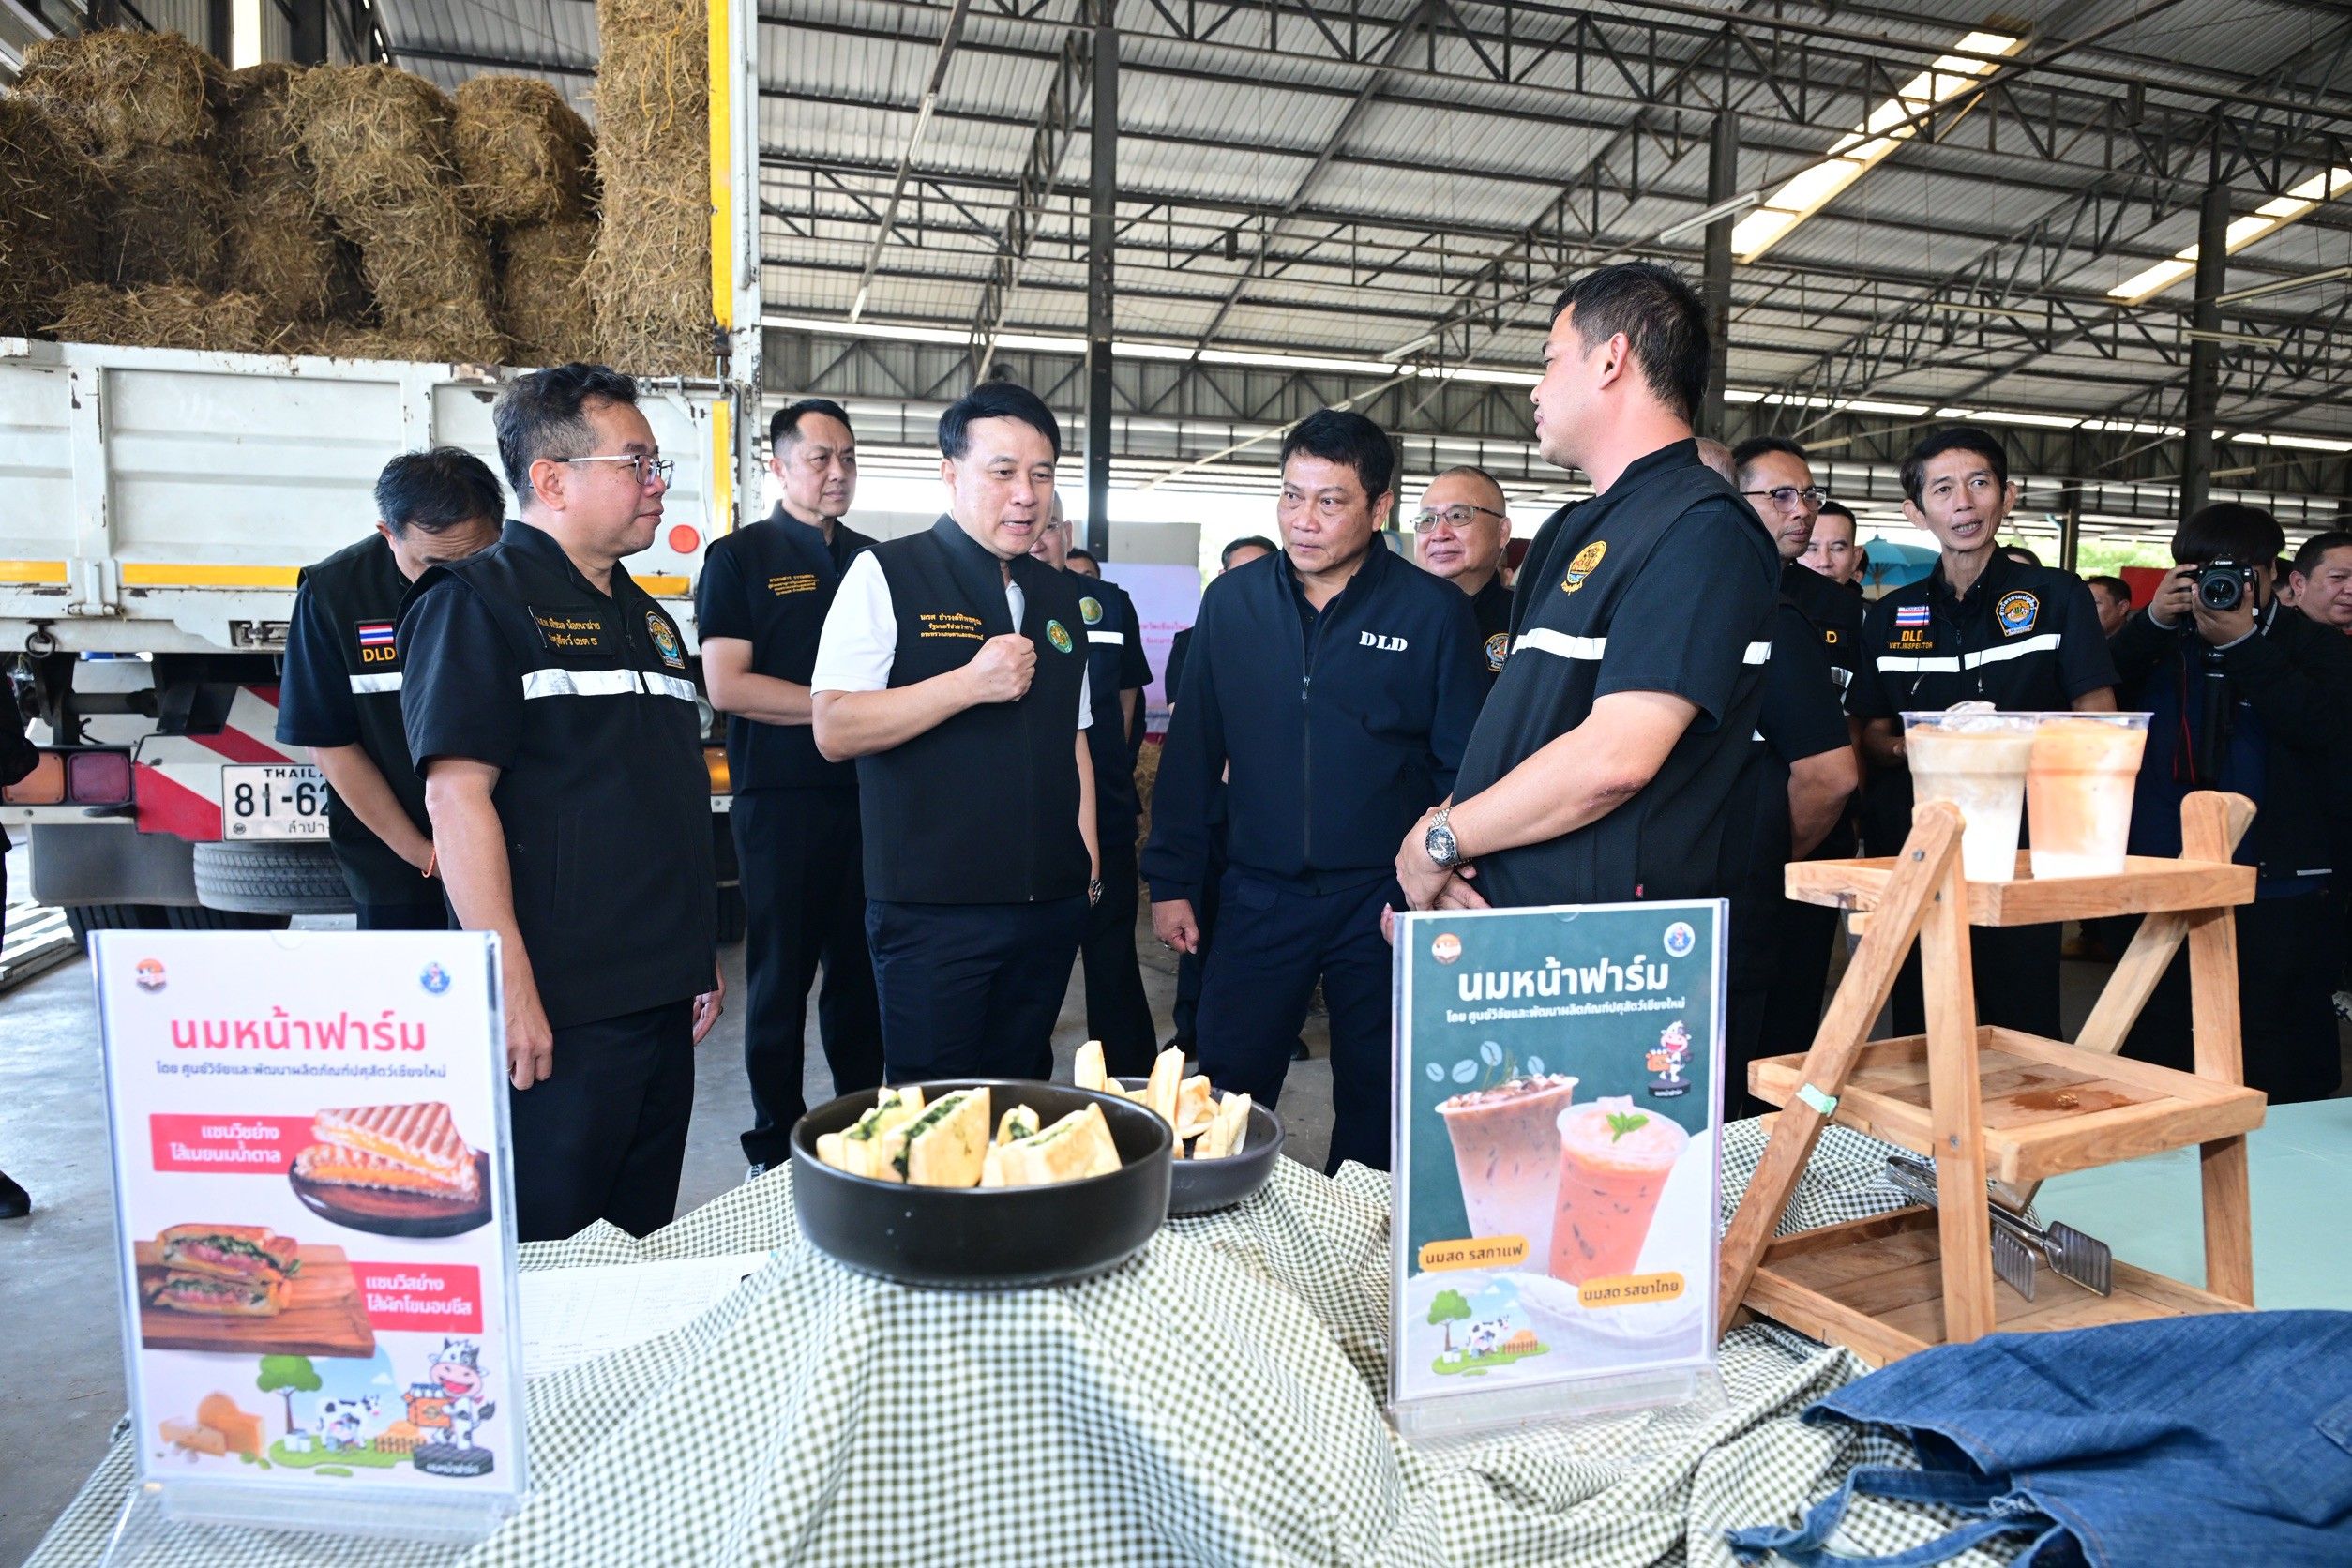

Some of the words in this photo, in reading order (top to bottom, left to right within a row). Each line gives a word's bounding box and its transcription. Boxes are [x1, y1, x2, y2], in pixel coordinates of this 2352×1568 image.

[1359, 630, 1408, 652] DLD
[362, 647, 397, 662] DLD
[288, 821, 330, 834] ลำปา
[1458, 954, 1669, 1002] นมหน้าฟาร์ม
[1446, 1009, 1467, 1023] โดย
[170, 1005, 427, 1052] นมหน้าฟาร์ม
[1425, 1250, 1465, 1264] นมสด
[1469, 1243, 1524, 1260] รสกาแฟ
[1584, 1288, 1621, 1301] นมสด
[1624, 1279, 1680, 1297] รสชาไทย
